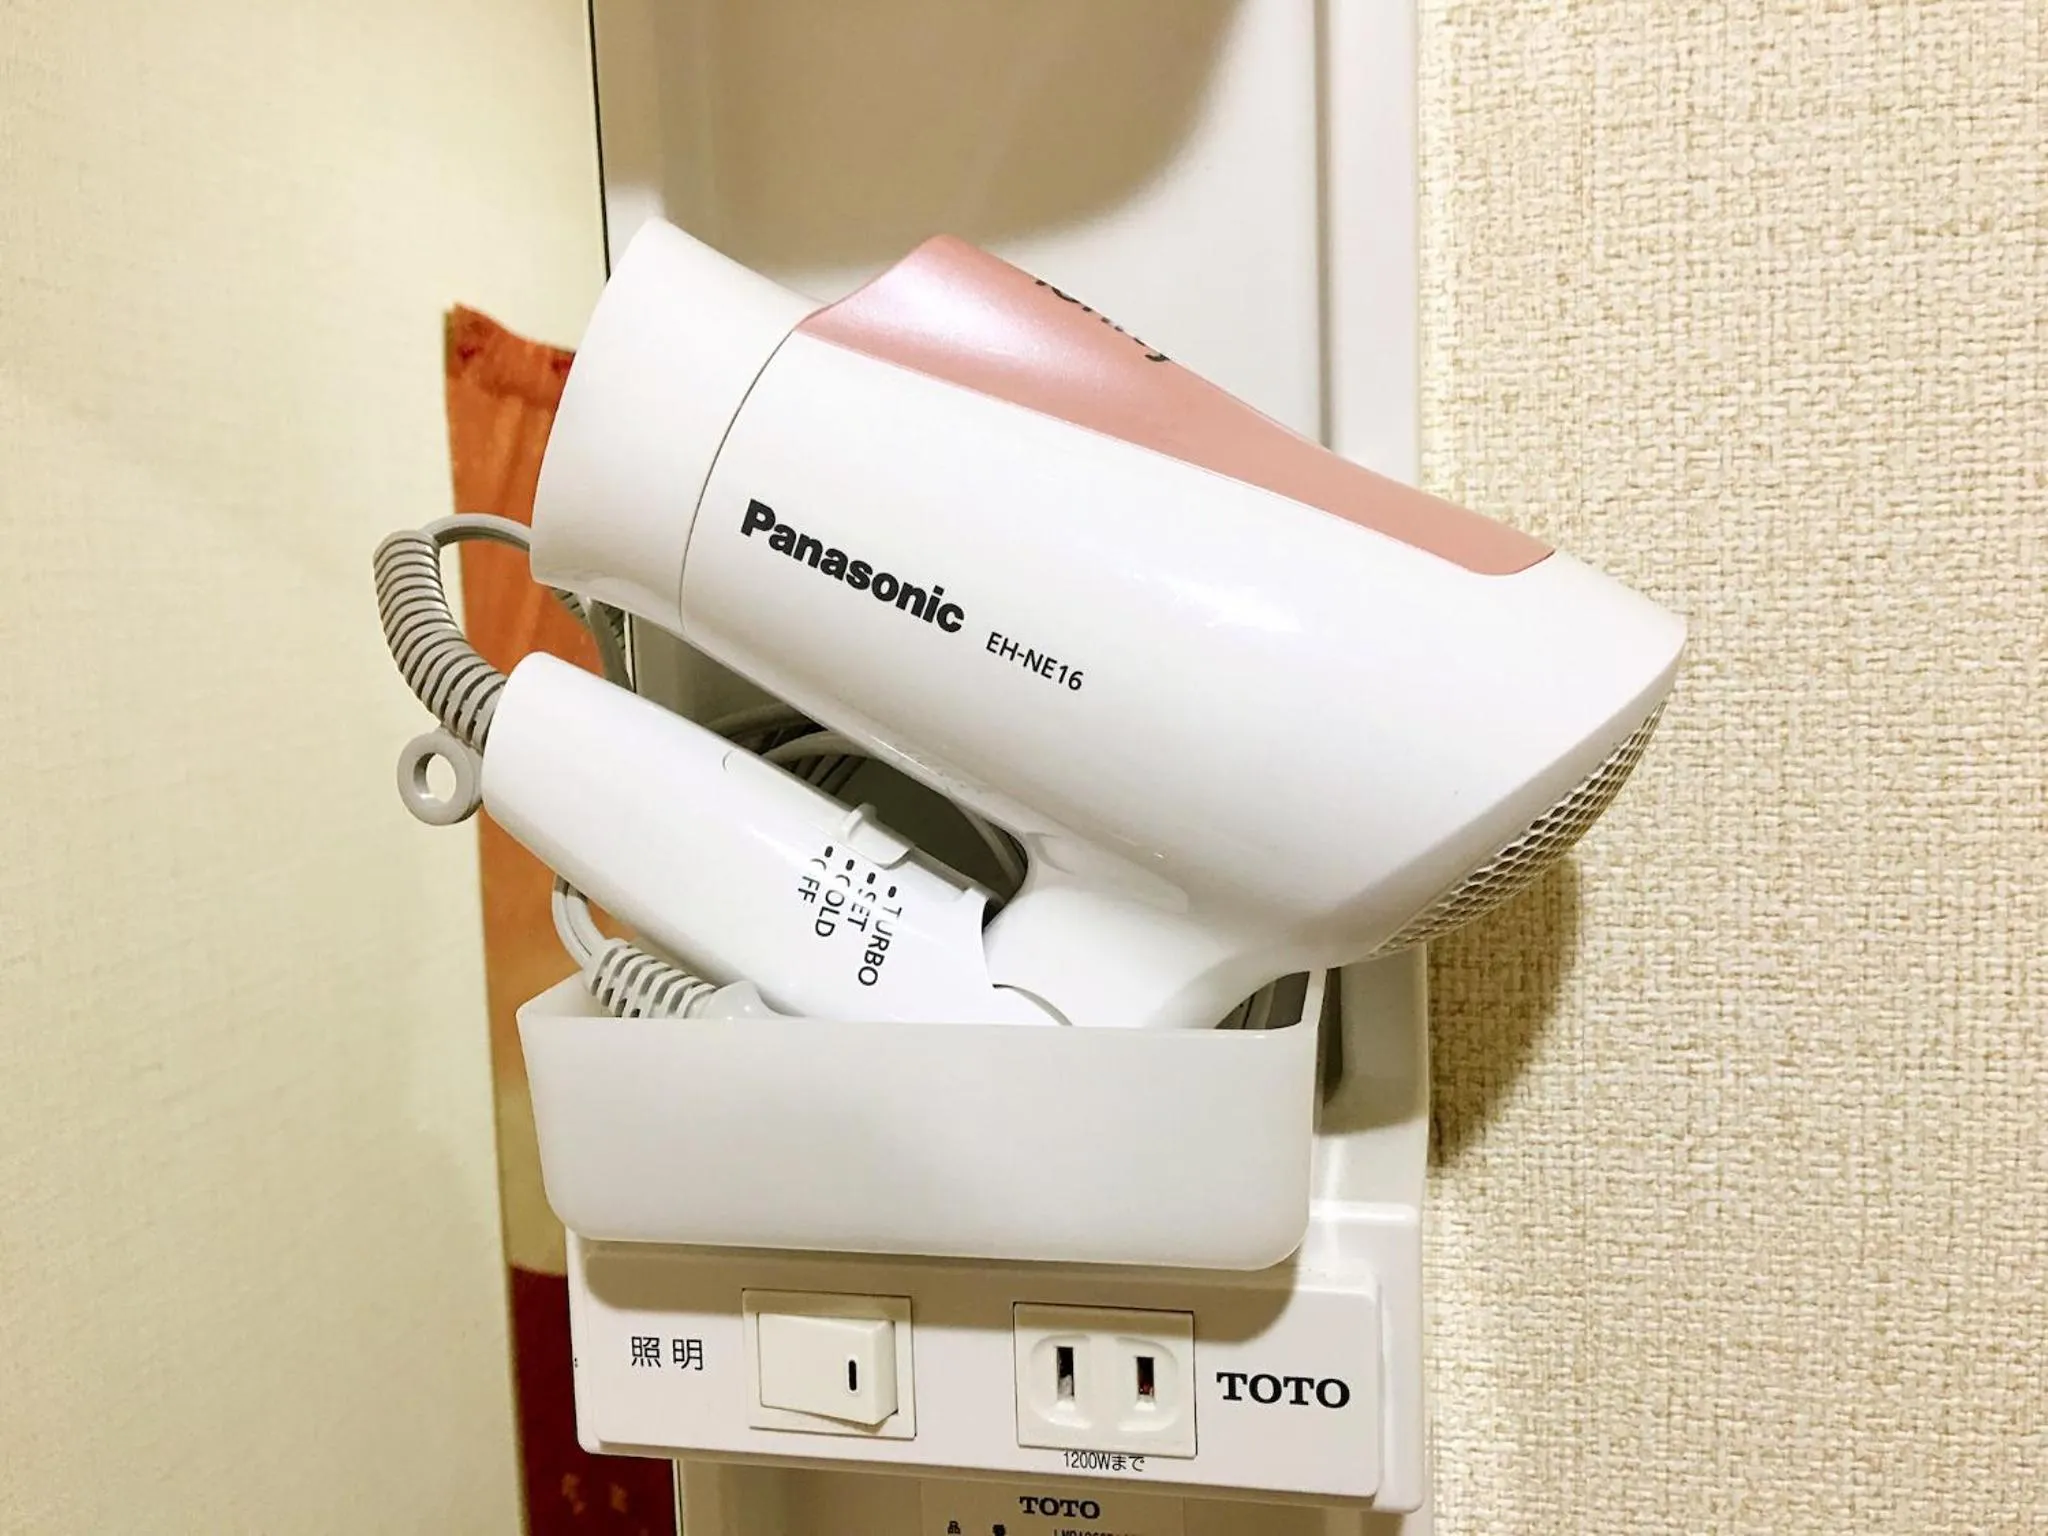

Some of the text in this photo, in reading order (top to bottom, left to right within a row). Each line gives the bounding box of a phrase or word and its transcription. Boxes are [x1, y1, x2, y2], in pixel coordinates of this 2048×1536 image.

[741, 499, 964, 632] Panasonic
[986, 631, 1084, 691] EH-NE16
[857, 907, 903, 986] TURBO
[1216, 1372, 1350, 1409] TOTO
[1063, 1451, 1145, 1472] 1200Wまで
[1019, 1496, 1101, 1520] TOTO
